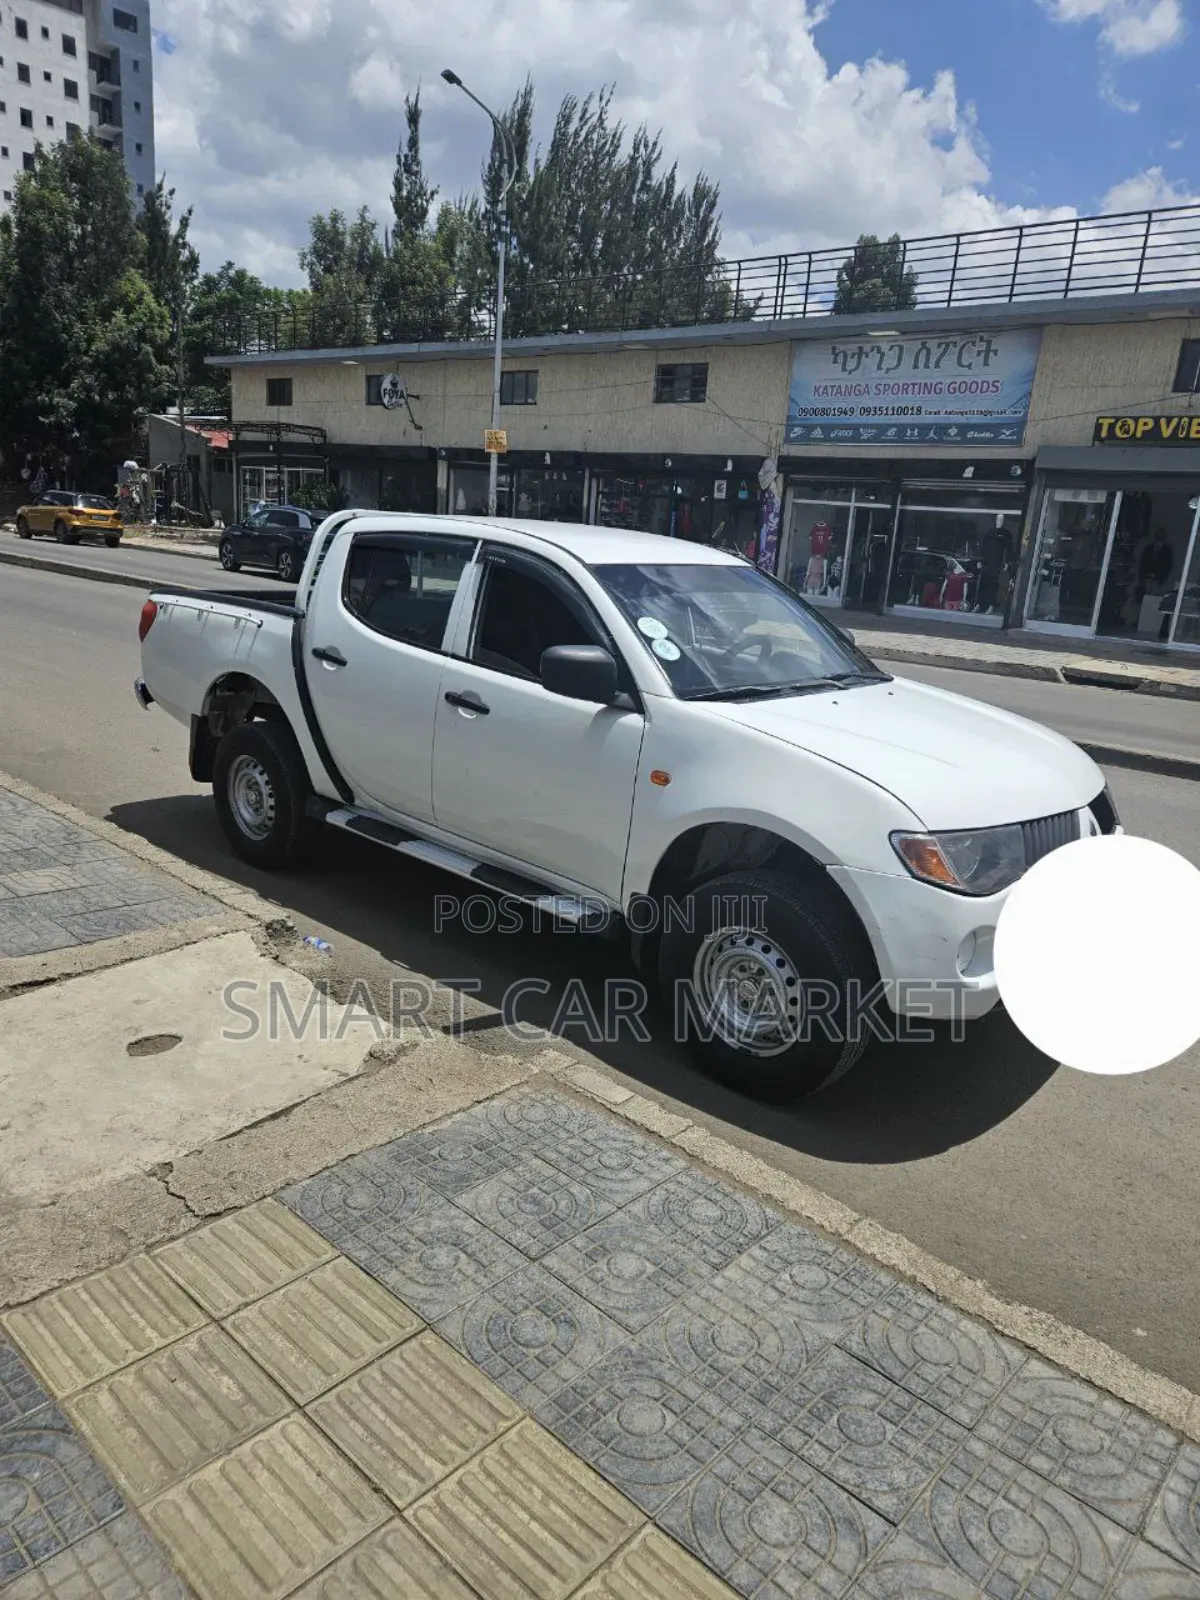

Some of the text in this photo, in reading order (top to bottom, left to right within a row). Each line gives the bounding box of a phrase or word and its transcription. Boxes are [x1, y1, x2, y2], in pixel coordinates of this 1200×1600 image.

[830, 336, 999, 375] ካታንጋ ስፖርት
[813, 380, 1000, 397] KATANGA SPORTING GOODS
[798, 406, 855, 417] 0900801949
[859, 405, 922, 416] 0935110018
[1098, 418, 1155, 438] TOP
